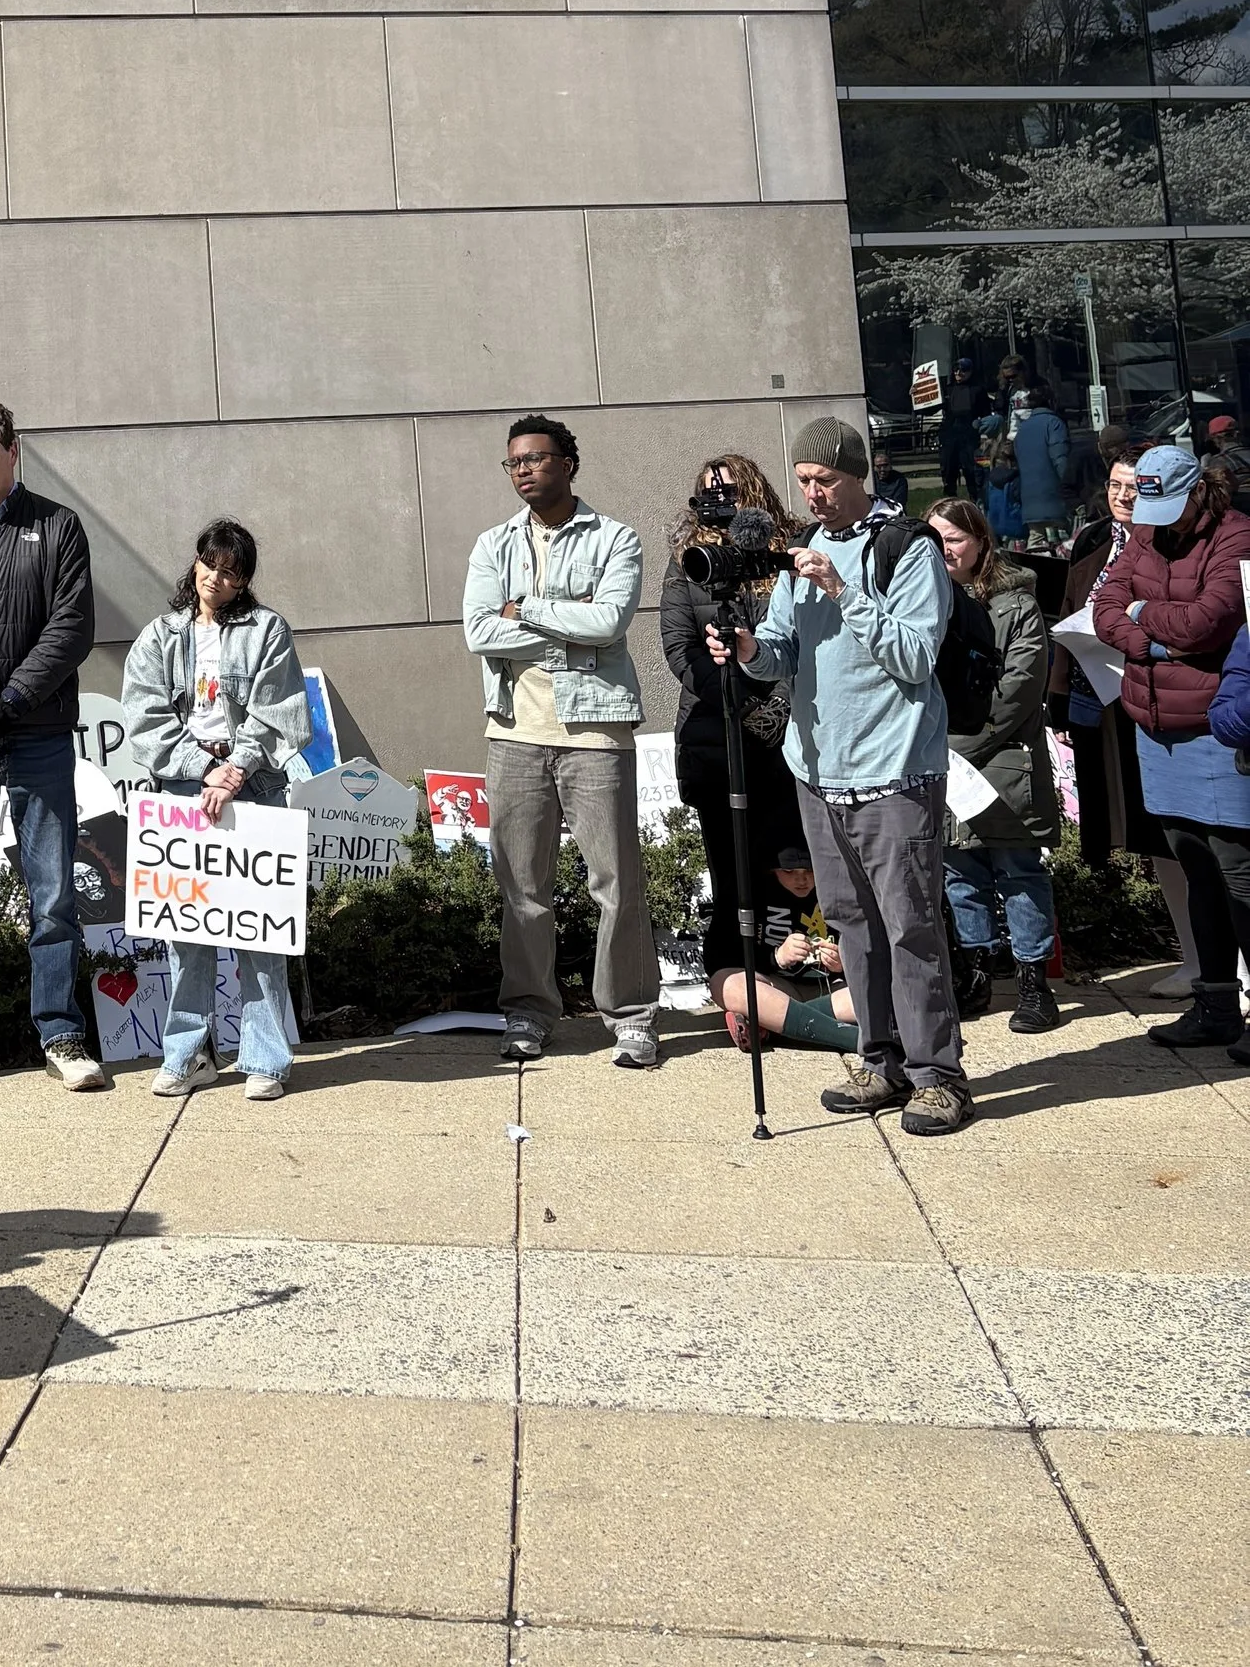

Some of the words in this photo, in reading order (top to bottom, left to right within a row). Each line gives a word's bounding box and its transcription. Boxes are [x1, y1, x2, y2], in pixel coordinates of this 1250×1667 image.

[138, 799, 211, 832] FUND
[321, 807, 360, 823] LOVING
[361, 812, 408, 831] MEMORY
[136, 829, 297, 886] SCIENCE
[307, 832, 400, 863] GENDER
[134, 869, 210, 904] FUCK
[307, 860, 390, 883] FFRMIN
[138, 900, 297, 946] FASCISM
